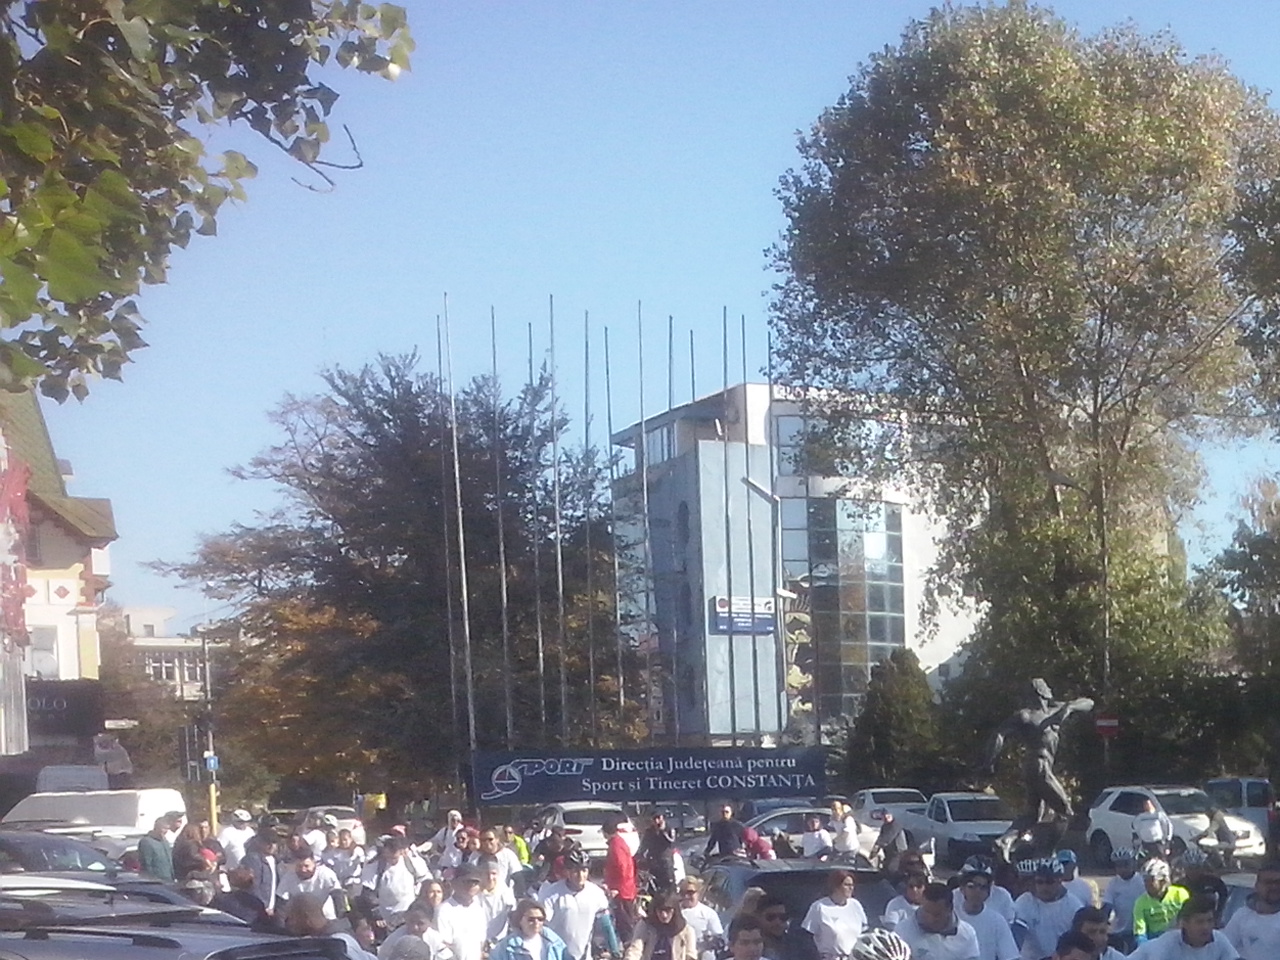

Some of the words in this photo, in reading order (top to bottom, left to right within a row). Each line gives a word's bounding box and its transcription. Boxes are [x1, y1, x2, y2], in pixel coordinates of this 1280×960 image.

[747, 757, 796, 772] pentru
[582, 778, 625, 795] Sport
[645, 776, 702, 790] Tineret
